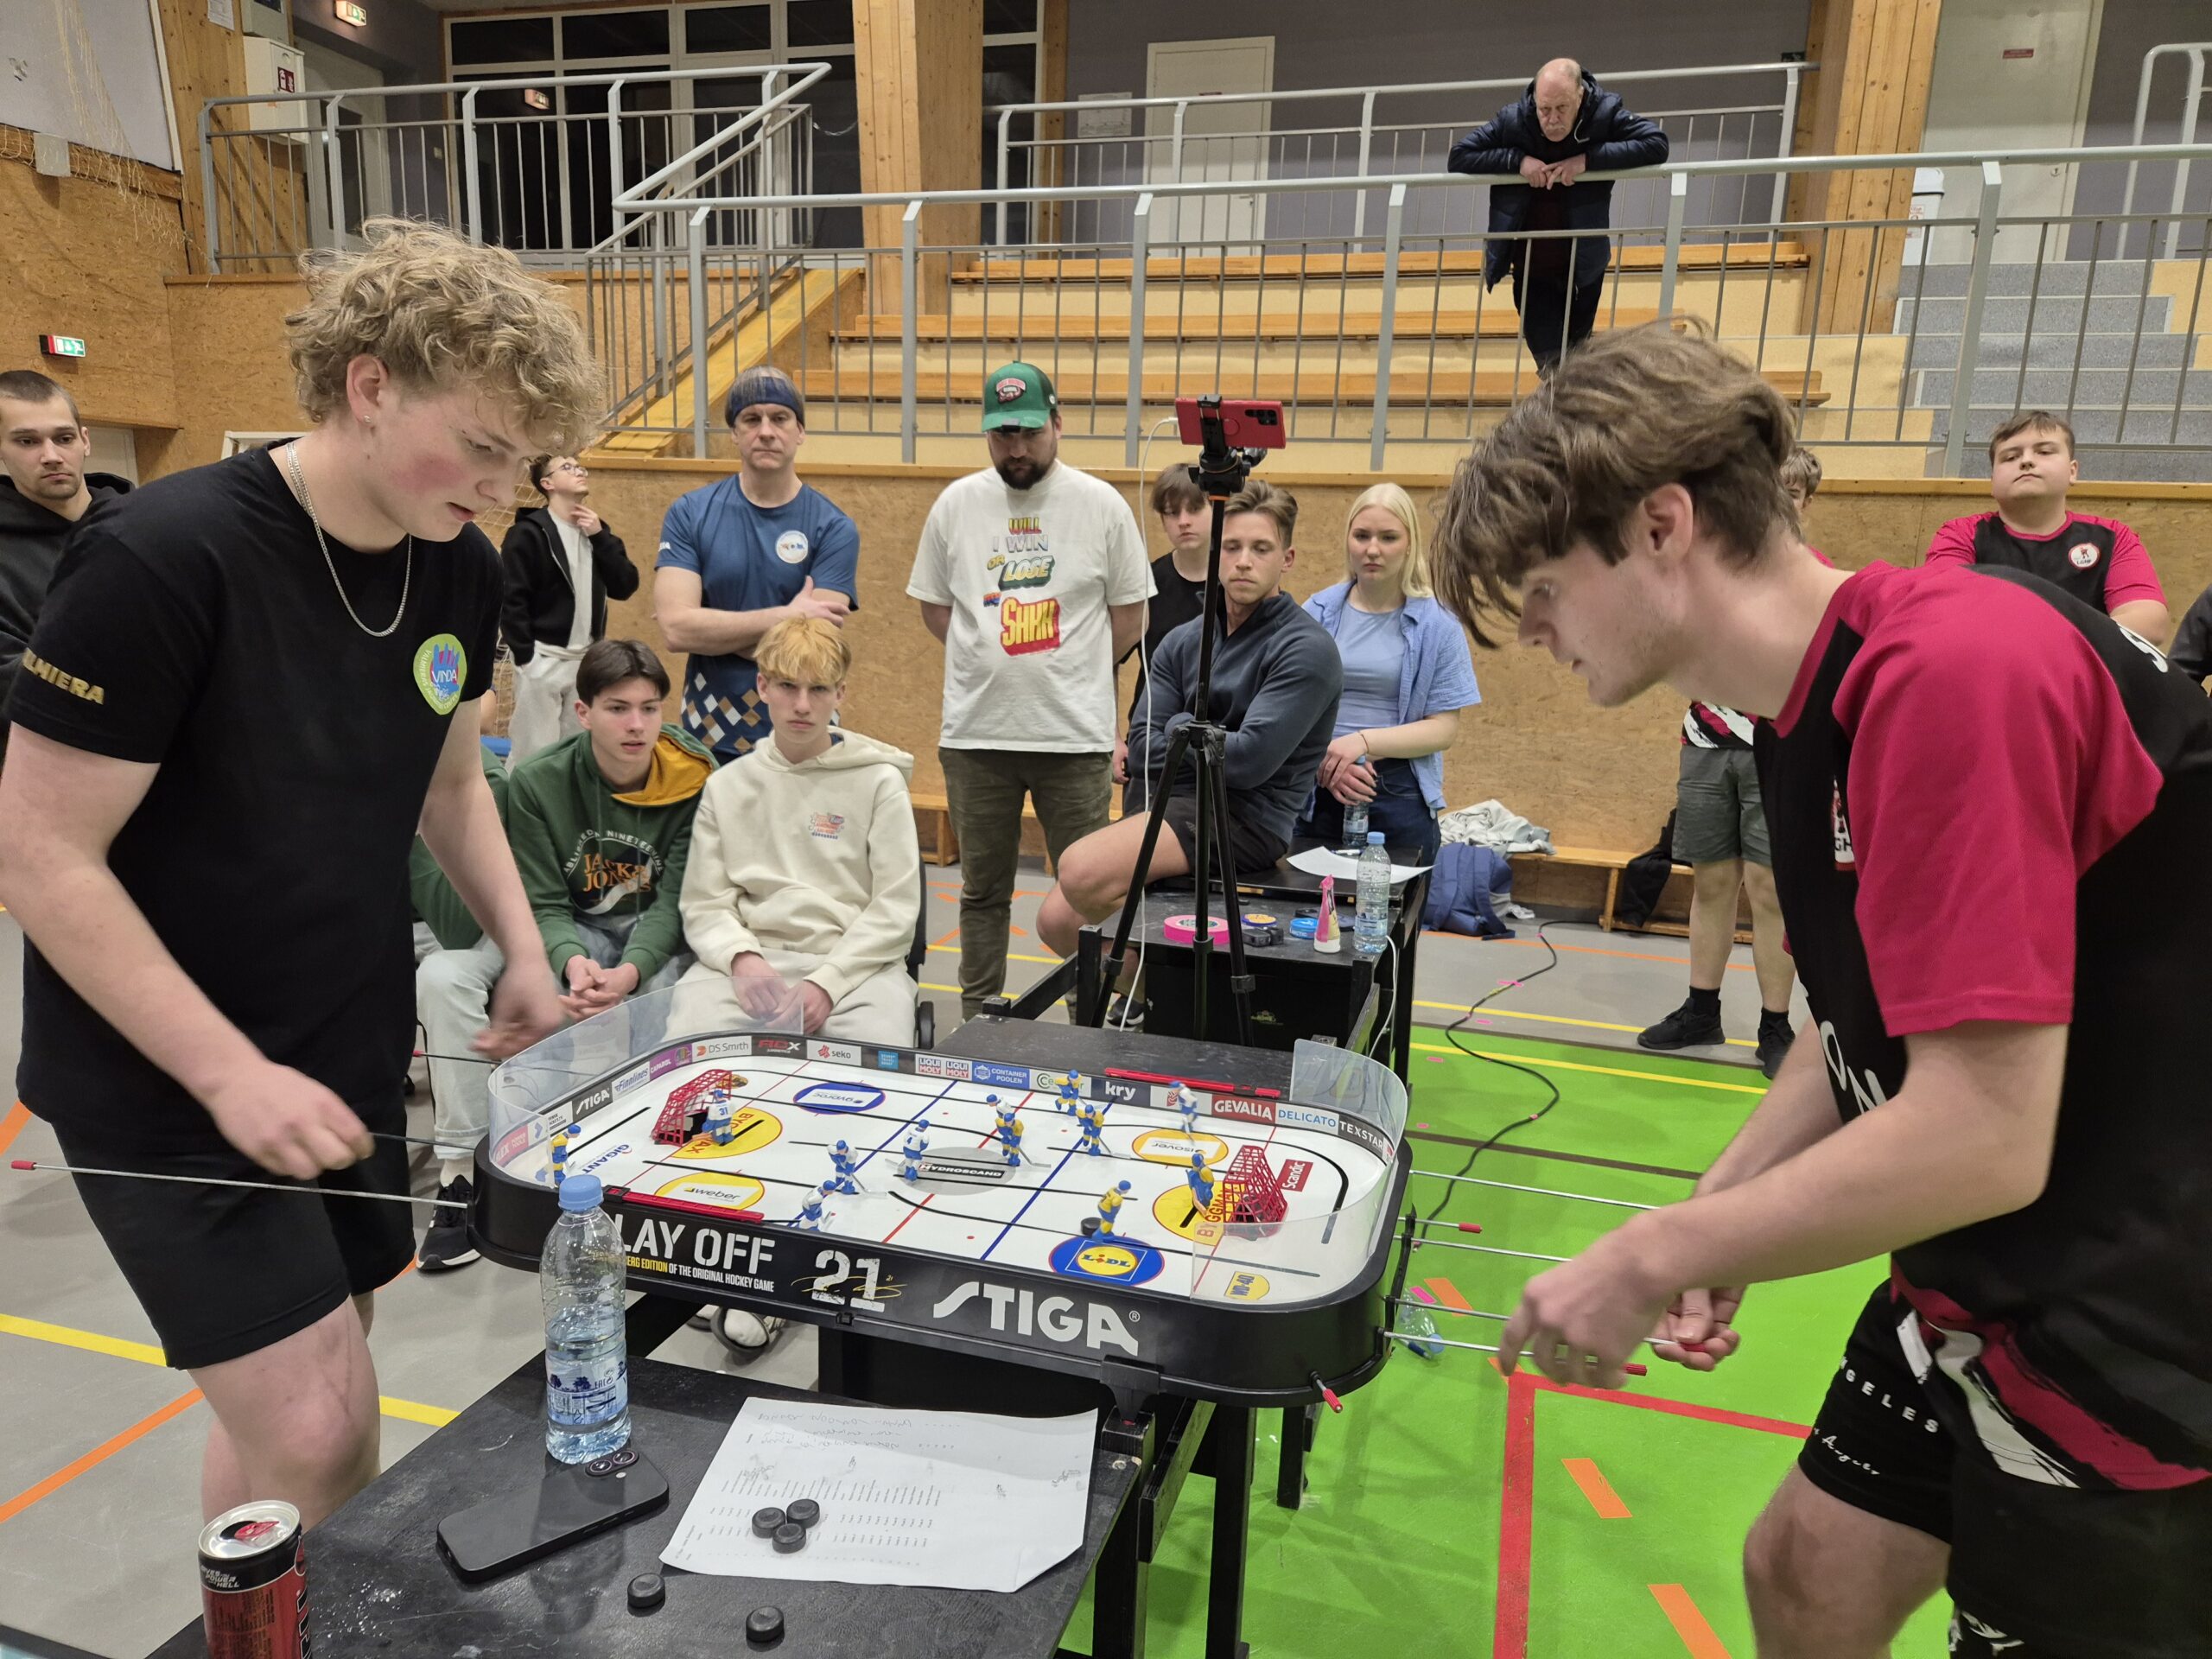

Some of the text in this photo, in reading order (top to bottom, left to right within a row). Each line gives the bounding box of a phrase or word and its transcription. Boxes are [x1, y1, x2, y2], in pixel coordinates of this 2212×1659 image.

[1008, 517, 1042, 535] WILL
[1007, 534, 1049, 553] WIN
[1000, 555, 1055, 588] LOSE
[709, 1041, 749, 1053] DS Smith
[831, 1050, 852, 1059] seko
[919, 1057, 941, 1067] LIQUI
[919, 1065, 941, 1074] MOLY
[946, 1060, 969, 1071] LIQUI
[946, 1068, 969, 1078] MOLY
[991, 1068, 1027, 1078] CONTAINER
[1105, 1081, 1136, 1101] kry
[576, 1088, 610, 1115] STIGA
[1214, 1099, 1273, 1121] GEVALIA
[719, 1108, 728, 1116] 31
[1278, 1109, 1337, 1128] DELICATO
[1339, 1121, 1383, 1150] TEXSTAR
[582, 1144, 630, 1174] GIGANT
[918, 1163, 1002, 1177] HYDROSCAND
[1282, 1161, 1305, 1190] Scandic
[694, 1187, 741, 1200] weber
[614, 1213, 775, 1274] LAY OFF
[1081, 1254, 1131, 1268] LIDL
[641, 1258, 668, 1273] EDITION
[669, 1263, 678, 1275] OF
[678, 1265, 692, 1277] THE
[692, 1267, 724, 1284] ORIGINAL
[724, 1274, 753, 1289] HOCKEY
[753, 1278, 775, 1293] GAME
[811, 1249, 885, 1313] 21
